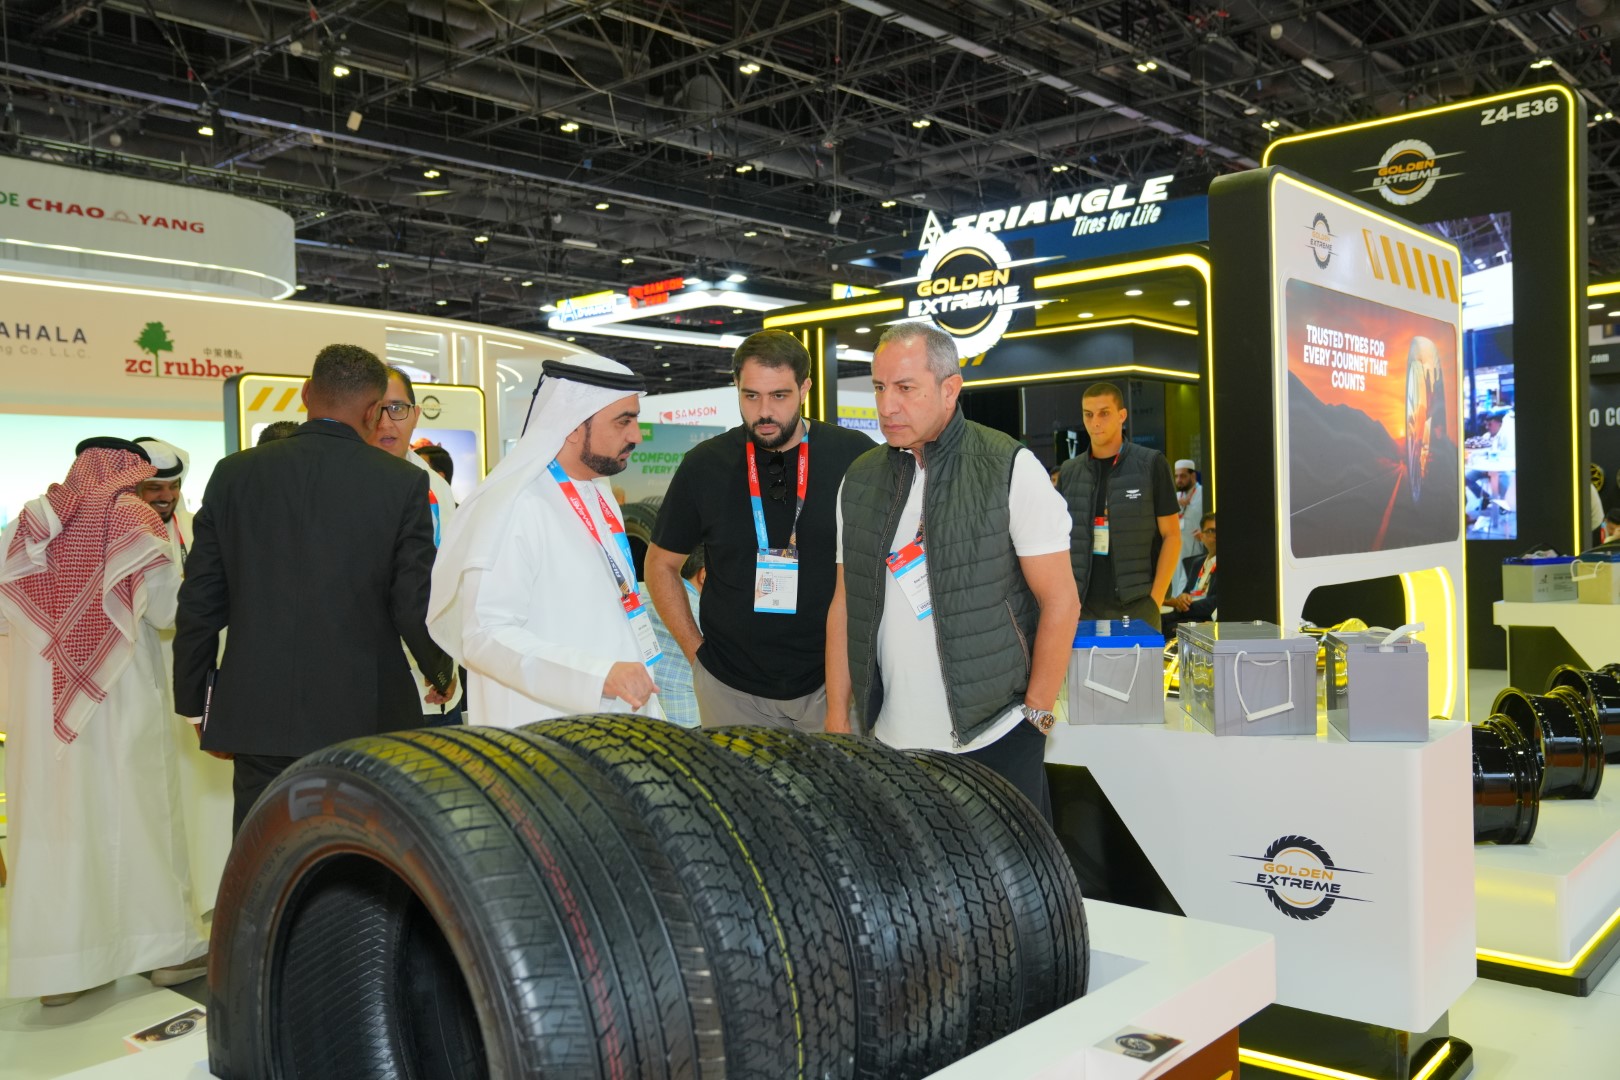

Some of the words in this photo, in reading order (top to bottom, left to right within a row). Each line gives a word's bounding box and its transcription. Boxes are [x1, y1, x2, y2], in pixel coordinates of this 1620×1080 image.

[1480, 96, 1559, 126] Z4-E36
[1372, 166, 1441, 188] EXTREME
[1378, 158, 1436, 177] GOLDEN
[26, 197, 105, 219] CHAO
[138, 213, 205, 234] YANG
[951, 174, 1175, 233] TRIANGLE
[1072, 215, 1106, 238] Tires
[1107, 209, 1131, 226] for
[1131, 203, 1163, 227] Life
[916, 268, 1011, 298] GOLDEN
[907, 284, 1021, 318] EXTREME
[1306, 324, 1343, 349] TRUSTED
[1344, 333, 1369, 355] TYRES
[1369, 339, 1385, 358] FOR
[125, 358, 152, 373] zc
[164, 358, 244, 378] rubber
[1303, 344, 1331, 367] EVERY
[1331, 350, 1369, 373] JOURNEY
[1369, 358, 1388, 377] THAT
[1331, 370, 1366, 391] COUNTS
[675, 406, 717, 418] SAMSON
[641, 465, 673, 474] EVERY
[1256, 873, 1342, 894] EXTREME
[1263, 863, 1334, 881] GOLDEN
